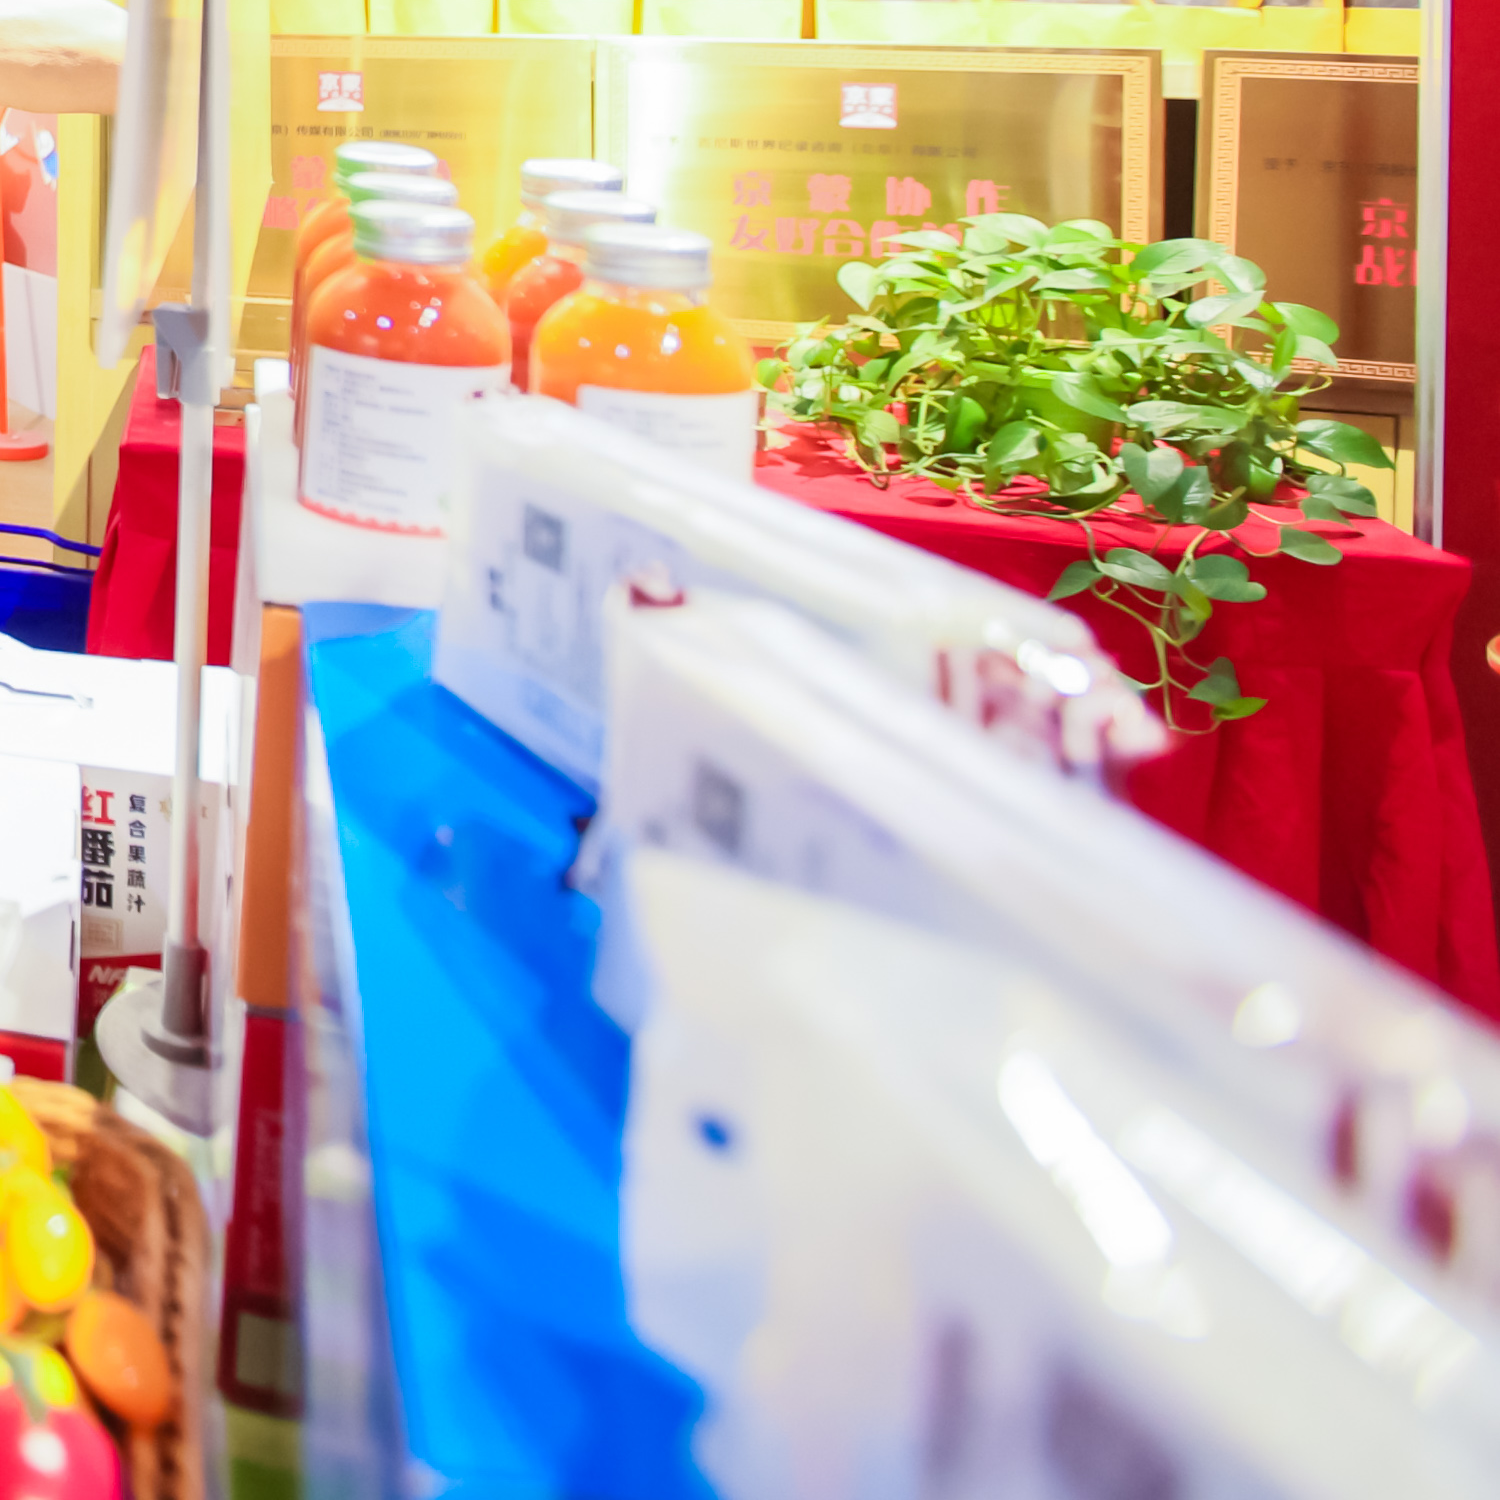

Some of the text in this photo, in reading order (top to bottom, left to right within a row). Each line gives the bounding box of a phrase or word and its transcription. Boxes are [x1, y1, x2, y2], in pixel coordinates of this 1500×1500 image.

[732, 171, 1012, 217] 京蒙协作
[1359, 196, 1410, 240] 京
[1354, 244, 1418, 288] 战
[81, 783, 116, 910] 红番茄
[127, 793, 147, 913] 复合果蔬汁
